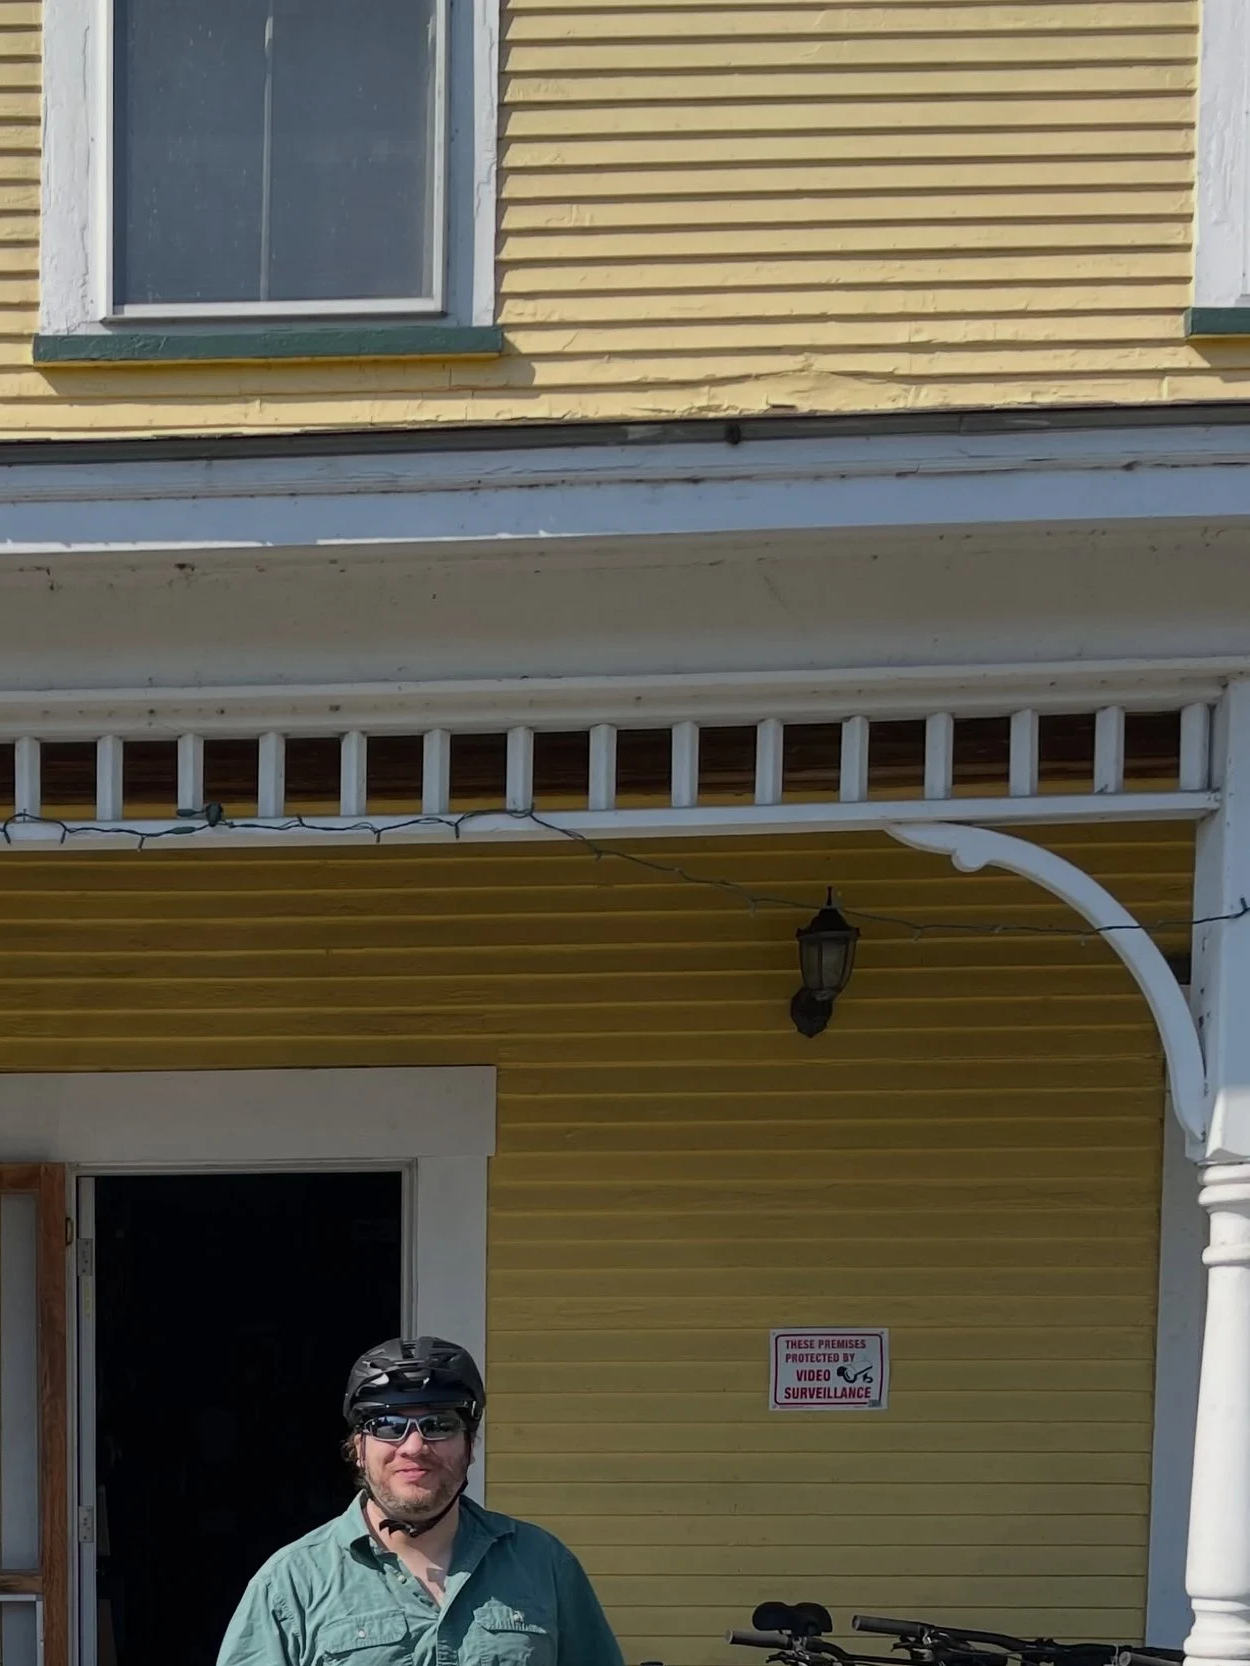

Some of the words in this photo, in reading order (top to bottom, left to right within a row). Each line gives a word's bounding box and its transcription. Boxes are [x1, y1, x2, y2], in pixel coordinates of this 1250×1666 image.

[785, 1340, 815, 1349] THESE
[818, 1339, 866, 1349] PREMISES
[786, 1353, 839, 1363] PROTECTED
[842, 1353, 855, 1362] BY
[796, 1369, 831, 1381] VIDEO
[784, 1387, 871, 1399] SURVEILLANCE
